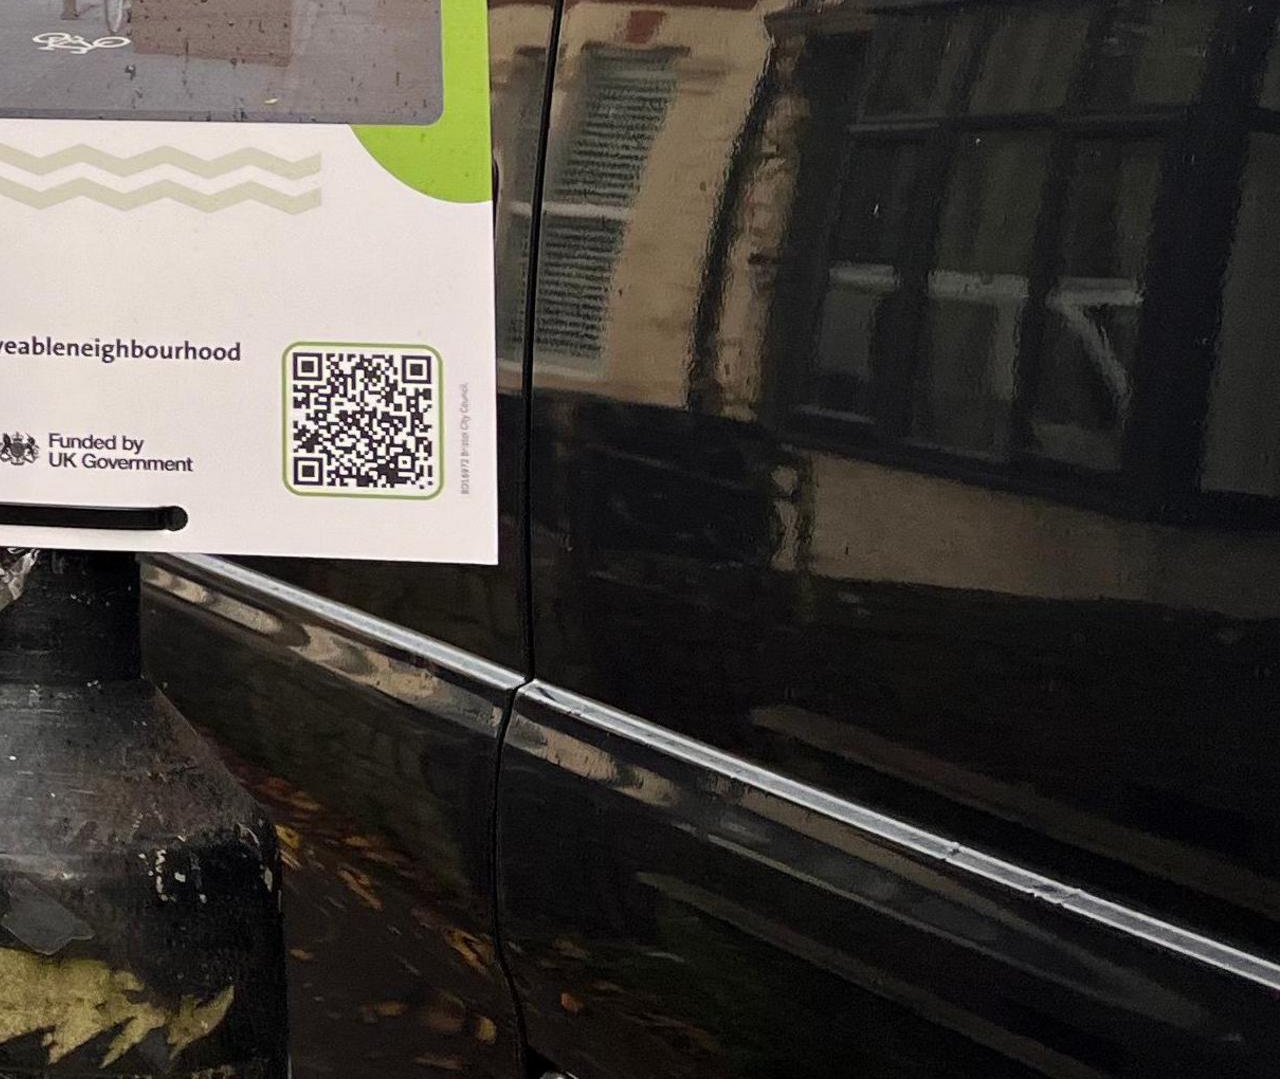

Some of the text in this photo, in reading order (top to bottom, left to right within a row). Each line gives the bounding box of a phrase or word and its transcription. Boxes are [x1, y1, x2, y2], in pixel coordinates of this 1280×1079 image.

[48, 432, 145, 455] Funded by
[48, 452, 194, 472] UK Government
